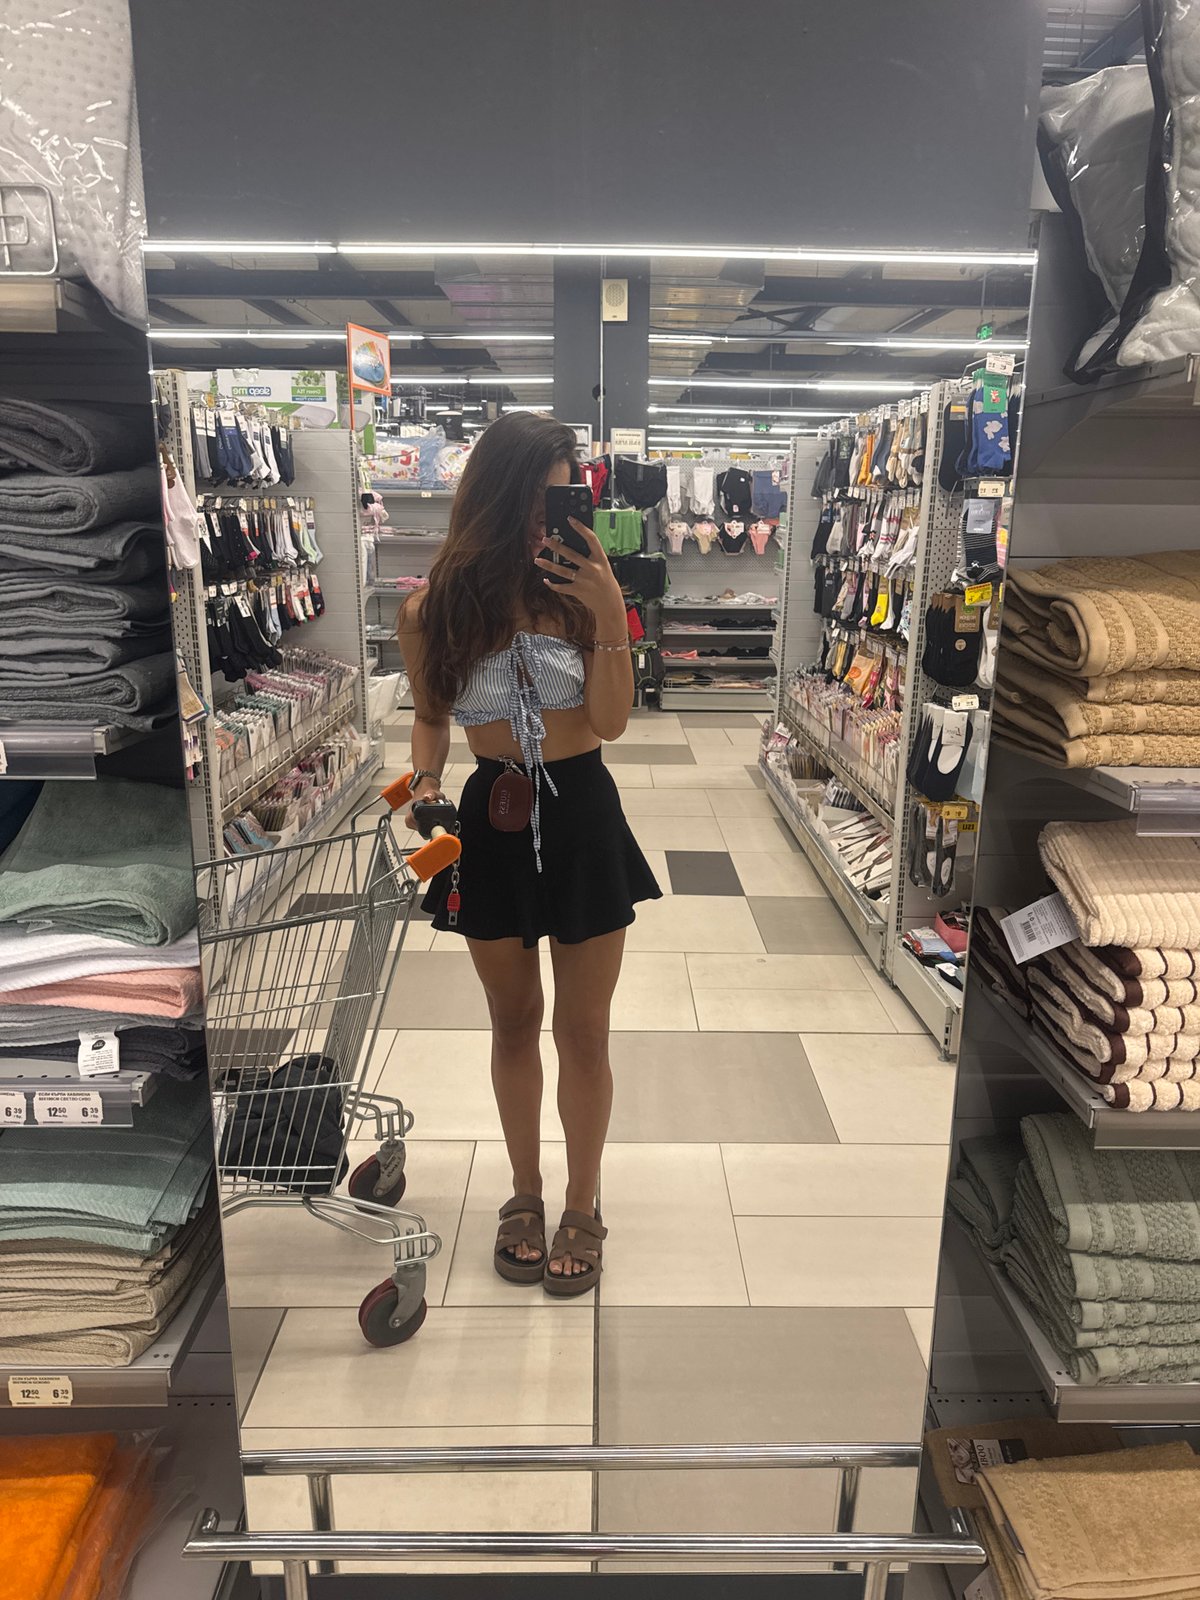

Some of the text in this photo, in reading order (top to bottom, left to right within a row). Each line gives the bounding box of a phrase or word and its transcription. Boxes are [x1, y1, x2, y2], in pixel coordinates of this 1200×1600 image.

[5, 1106, 12, 1117] 6
[82, 1107, 88, 1117] 6
[53, 1389, 59, 1398] 6
